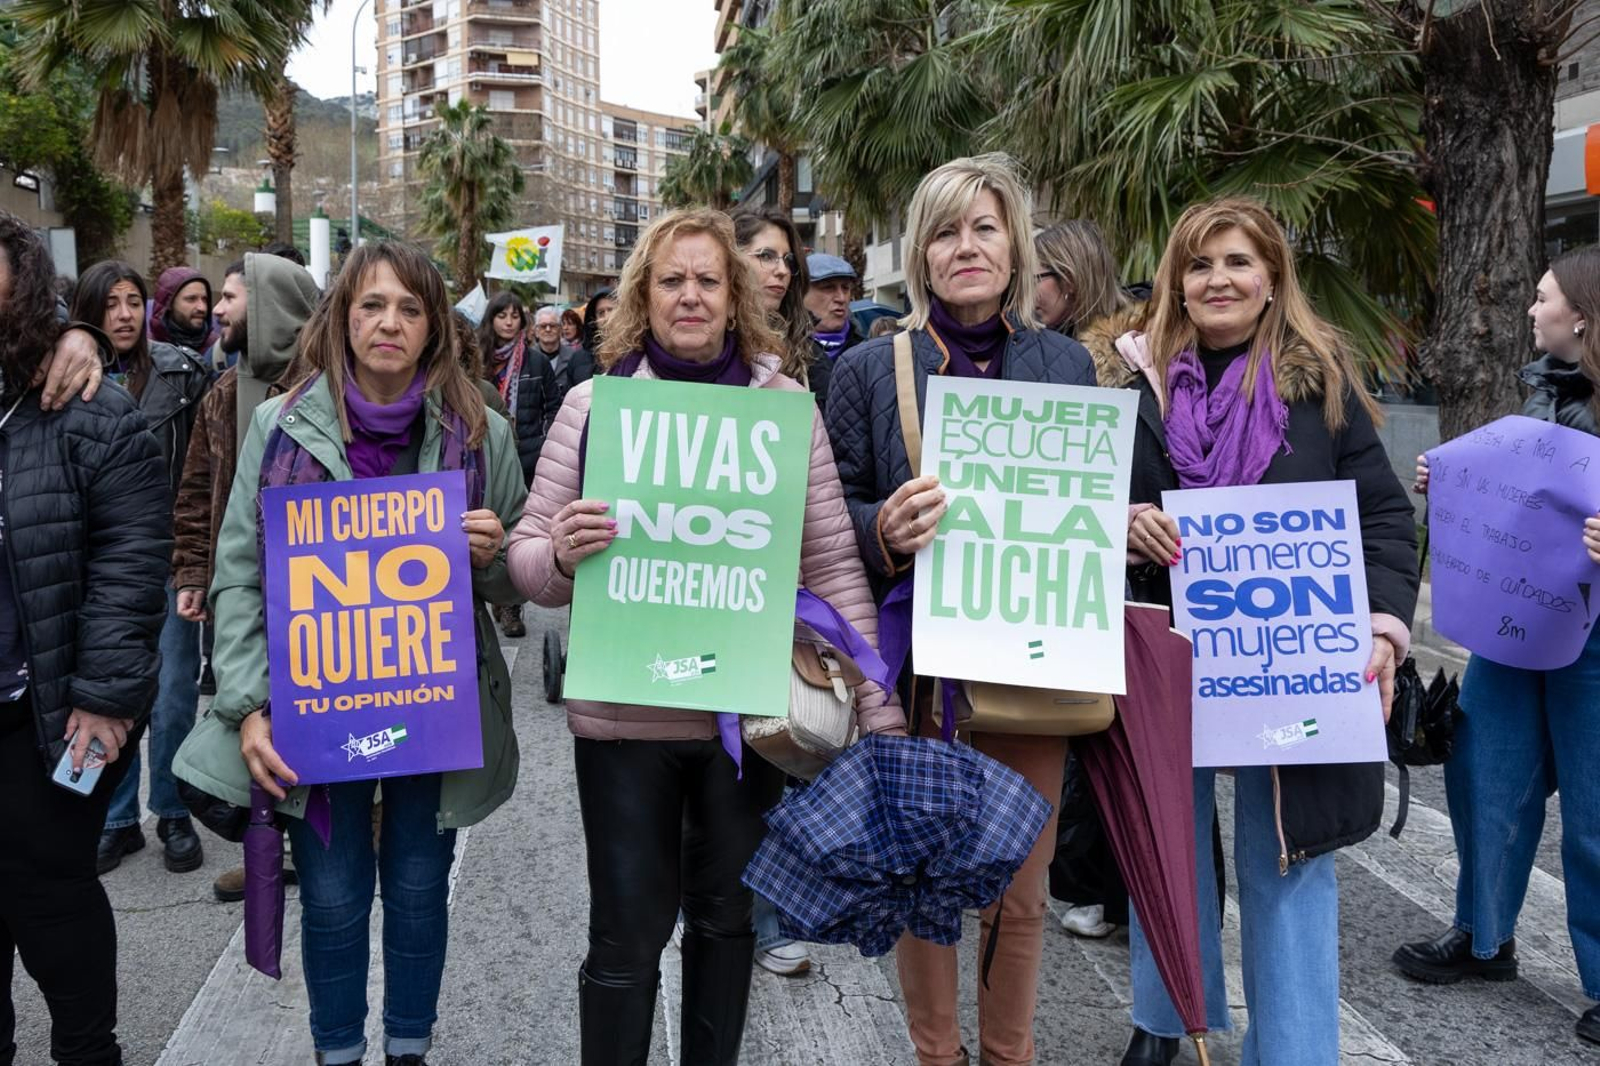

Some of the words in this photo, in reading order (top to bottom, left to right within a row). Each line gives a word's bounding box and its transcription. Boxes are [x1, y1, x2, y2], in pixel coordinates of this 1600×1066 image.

[942, 392, 1120, 429] MUJER
[620, 408, 780, 495] VIVAS
[940, 418, 1118, 466] ESCUCHA
[1569, 456, 1590, 473] A
[938, 449, 1115, 501] ÚNETE
[286, 499, 324, 545] MI
[331, 487, 445, 542] CUERPO
[615, 499, 772, 550] NOS
[936, 495, 996, 539] A
[1003, 499, 1114, 548] LA
[1178, 512, 1245, 537] NO
[1252, 508, 1346, 534] SON
[1482, 523, 1532, 553] TRABAJO
[288, 545, 451, 611] NO
[1182, 536, 1351, 574] números
[1476, 568, 1491, 584] DE
[608, 556, 767, 613] QUEREMOS
[930, 539, 1110, 631] LUCHA
[1185, 574, 1354, 621] SON
[288, 601, 457, 690] QUIERE
[1192, 617, 1360, 668] mujeres
[673, 658, 699, 675] JSA
[1198, 666, 1362, 698] asesinadas
[294, 699, 330, 715] TU
[334, 684, 455, 713] OPINIÓN
[366, 731, 391, 750] JSA
[1279, 724, 1305, 740] JSA
